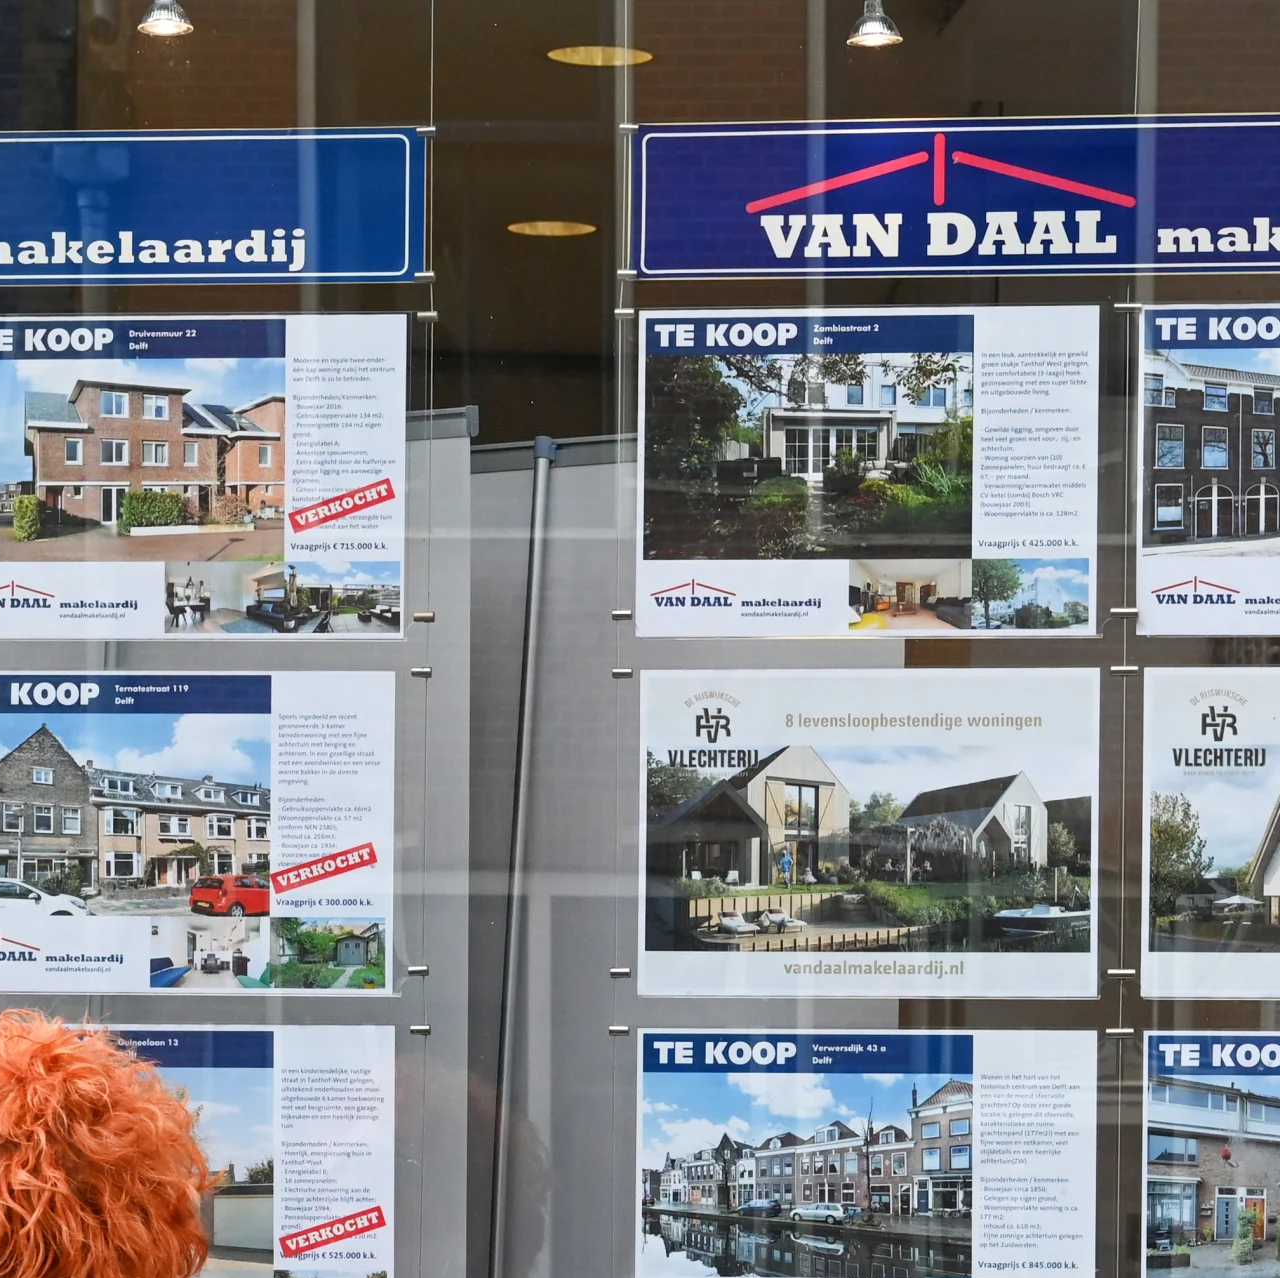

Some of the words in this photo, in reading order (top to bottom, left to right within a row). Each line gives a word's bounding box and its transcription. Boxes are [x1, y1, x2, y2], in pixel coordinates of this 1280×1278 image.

[761, 213, 902, 259] VAN
[925, 209, 1118, 256] DAAL
[185, 330, 196, 338] 22
[814, 324, 870, 333] Zambiastraat
[874, 324, 879, 332] 2
[1156, 317, 1197, 340] TE
[25, 328, 114, 351] KOOP
[129, 342, 148, 350] Delft
[814, 336, 833, 345] Delft
[294, 484, 389, 526] VERKOCHT
[291, 542, 330, 552] Vraagprijs
[339, 542, 372, 550] 715.000
[374, 542, 388, 550] k.k.
[655, 597, 687, 607] VAN
[690, 596, 732, 607] DAAL
[741, 598, 821, 609] makelaardij
[11, 682, 100, 705] KOOP
[115, 684, 170, 692] Ternatestraat
[173, 684, 189, 692] 119
[115, 696, 134, 705] Delft
[786, 714, 793, 728] 8
[799, 713, 962, 731] levensloopbestendige
[968, 714, 1042, 730] woningen
[668, 749, 759, 768] VLECHTERIJ
[1172, 748, 1266, 766] VLECHTERIJ
[276, 849, 371, 886] VERKOCHT
[784, 961, 964, 979] vandaalmakelaardij.nl
[812, 1044, 863, 1054] Verwersdijk
[867, 1044, 878, 1052] 43
[1159, 1044, 1200, 1067] TE
[812, 1057, 832, 1065] Delft
[285, 1211, 379, 1251] VERKOCHT
[978, 1261, 1019, 1271] Vraagprijs
[1022, 1261, 1026, 1269] €
[1029, 1261, 1061, 1269] 845.000
[1064, 1261, 1079, 1269] k.k.
